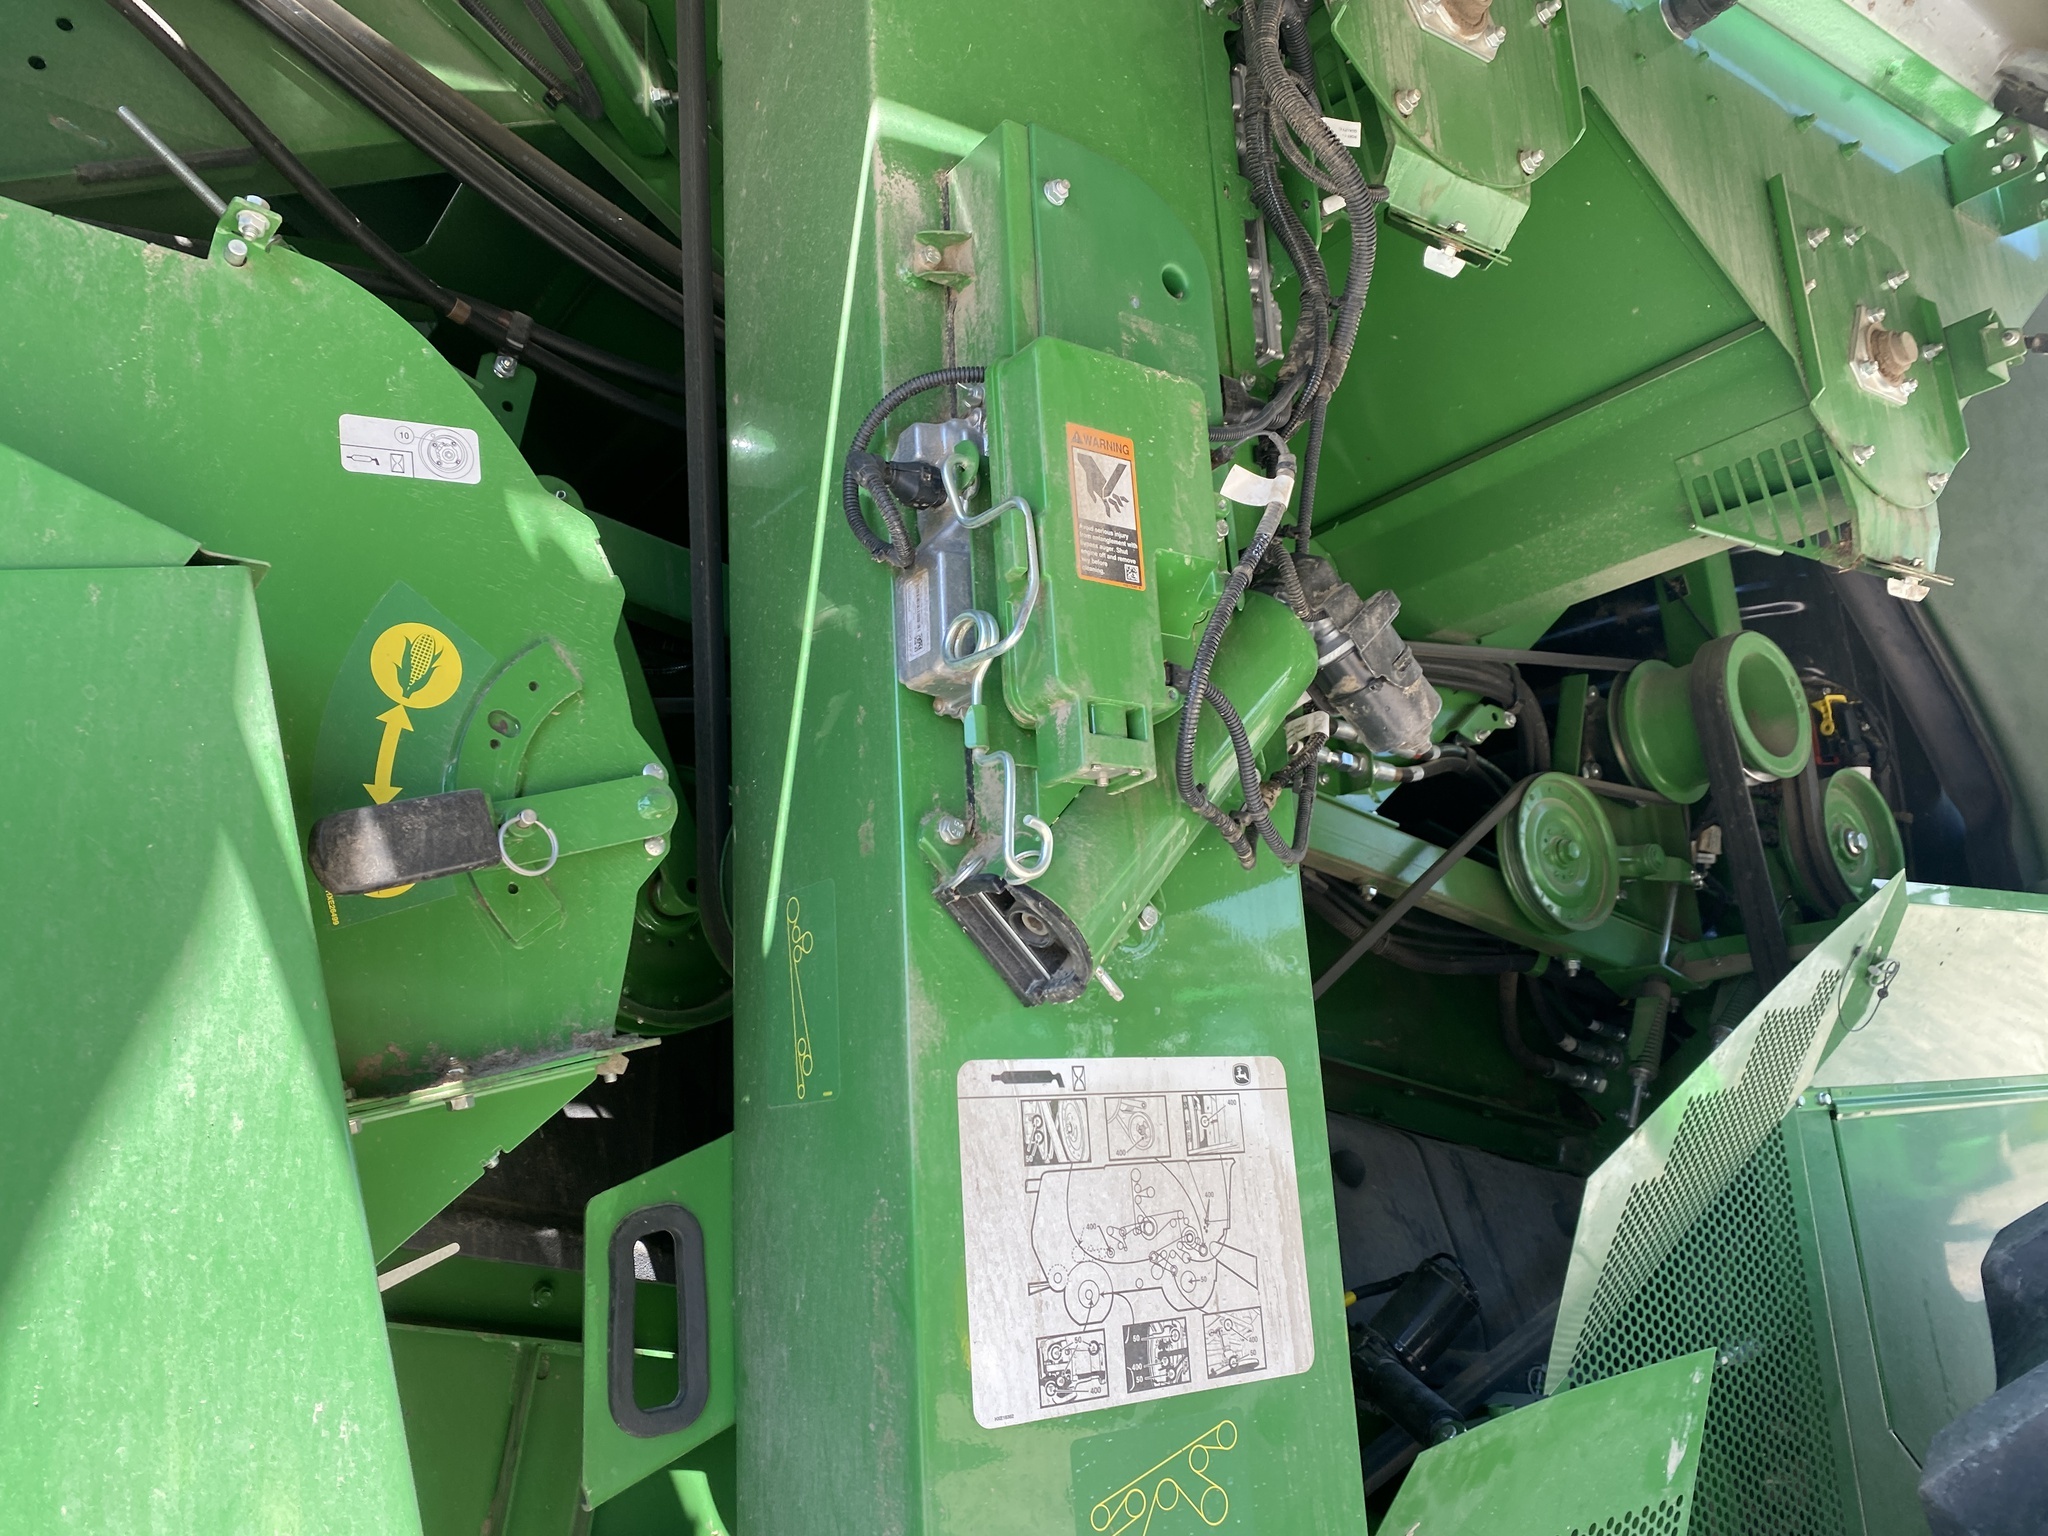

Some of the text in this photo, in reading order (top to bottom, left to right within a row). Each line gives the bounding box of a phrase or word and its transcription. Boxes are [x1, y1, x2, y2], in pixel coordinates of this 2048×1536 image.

[399, 431, 410, 440] 10
[1083, 434, 1130, 455] WARNING
[1094, 527, 1114, 536] serious
[1114, 530, 1129, 541] injury
[1092, 535, 1127, 547] entanglement
[1126, 541, 1138, 549] with
[1116, 546, 1129, 555] Shut
[1091, 558, 1108, 567] before
[1117, 556, 1137, 564] remove
[1115, 1149, 1127, 1157] 400
[1086, 1222, 1097, 1230] 400
[1074, 1336, 1082, 1344] 50
[1132, 1334, 1140, 1343] 50
[1131, 1362, 1143, 1371] 400
[1136, 1375, 1144, 1384] 50
[1090, 1386, 1102, 1394] 400
